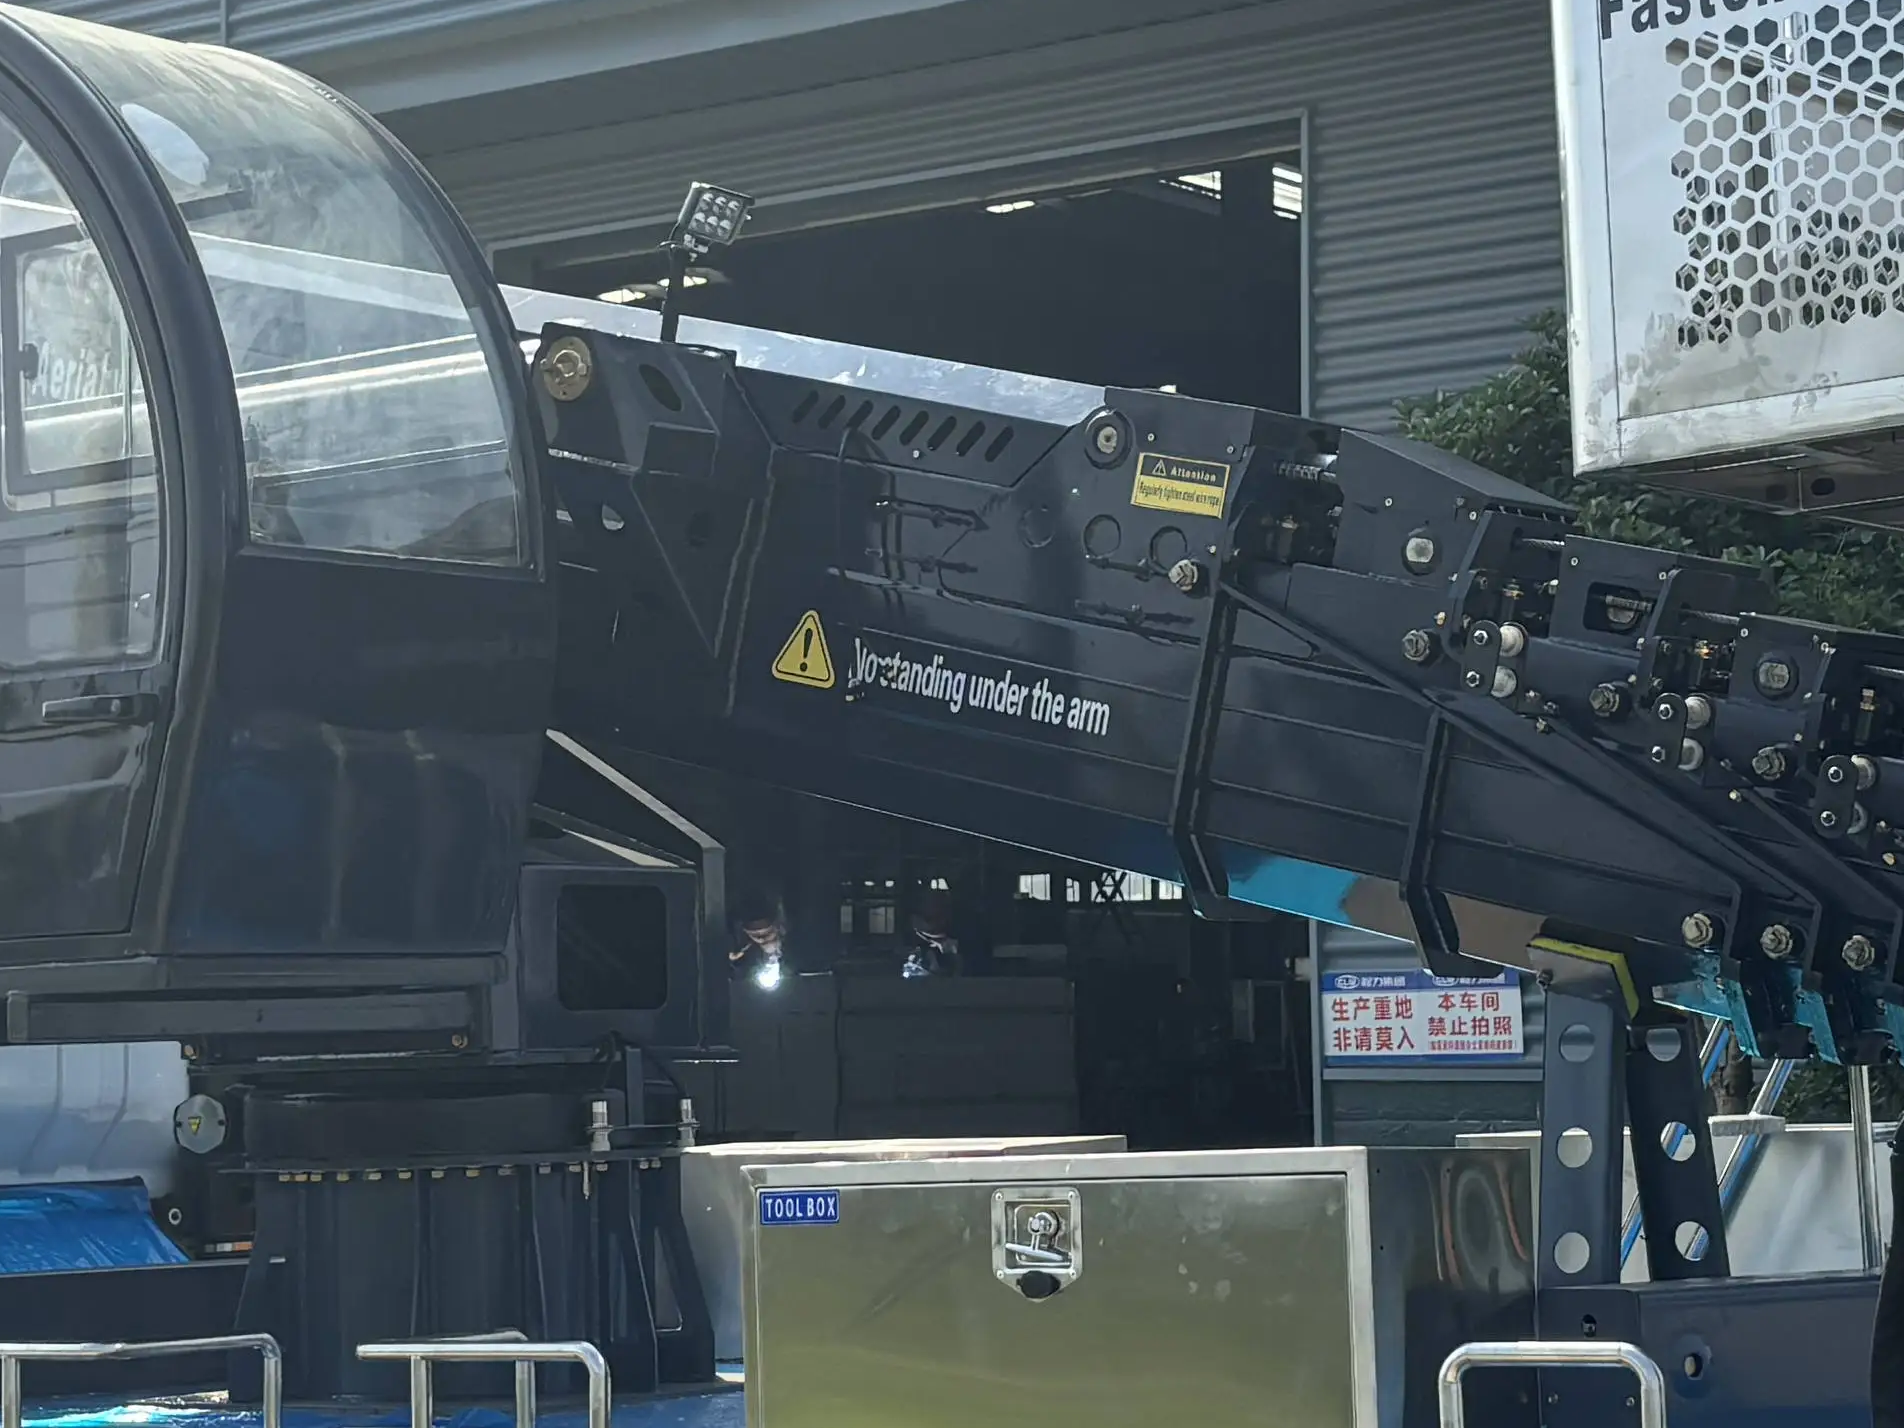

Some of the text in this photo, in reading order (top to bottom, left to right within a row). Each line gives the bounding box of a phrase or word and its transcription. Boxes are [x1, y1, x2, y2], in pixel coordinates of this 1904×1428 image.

[1170, 466, 1216, 482] Attention
[969, 670, 1029, 716] under
[1031, 678, 1064, 725] the
[1067, 696, 1110, 736] arm
[1331, 995, 1413, 1021] 生产重地
[1438, 992, 1500, 1013] 本车间
[1428, 1016, 1513, 1037] 禁止拍照
[1332, 1026, 1415, 1052] 非请莫入
[765, 1196, 836, 1218] TOOL BOX
